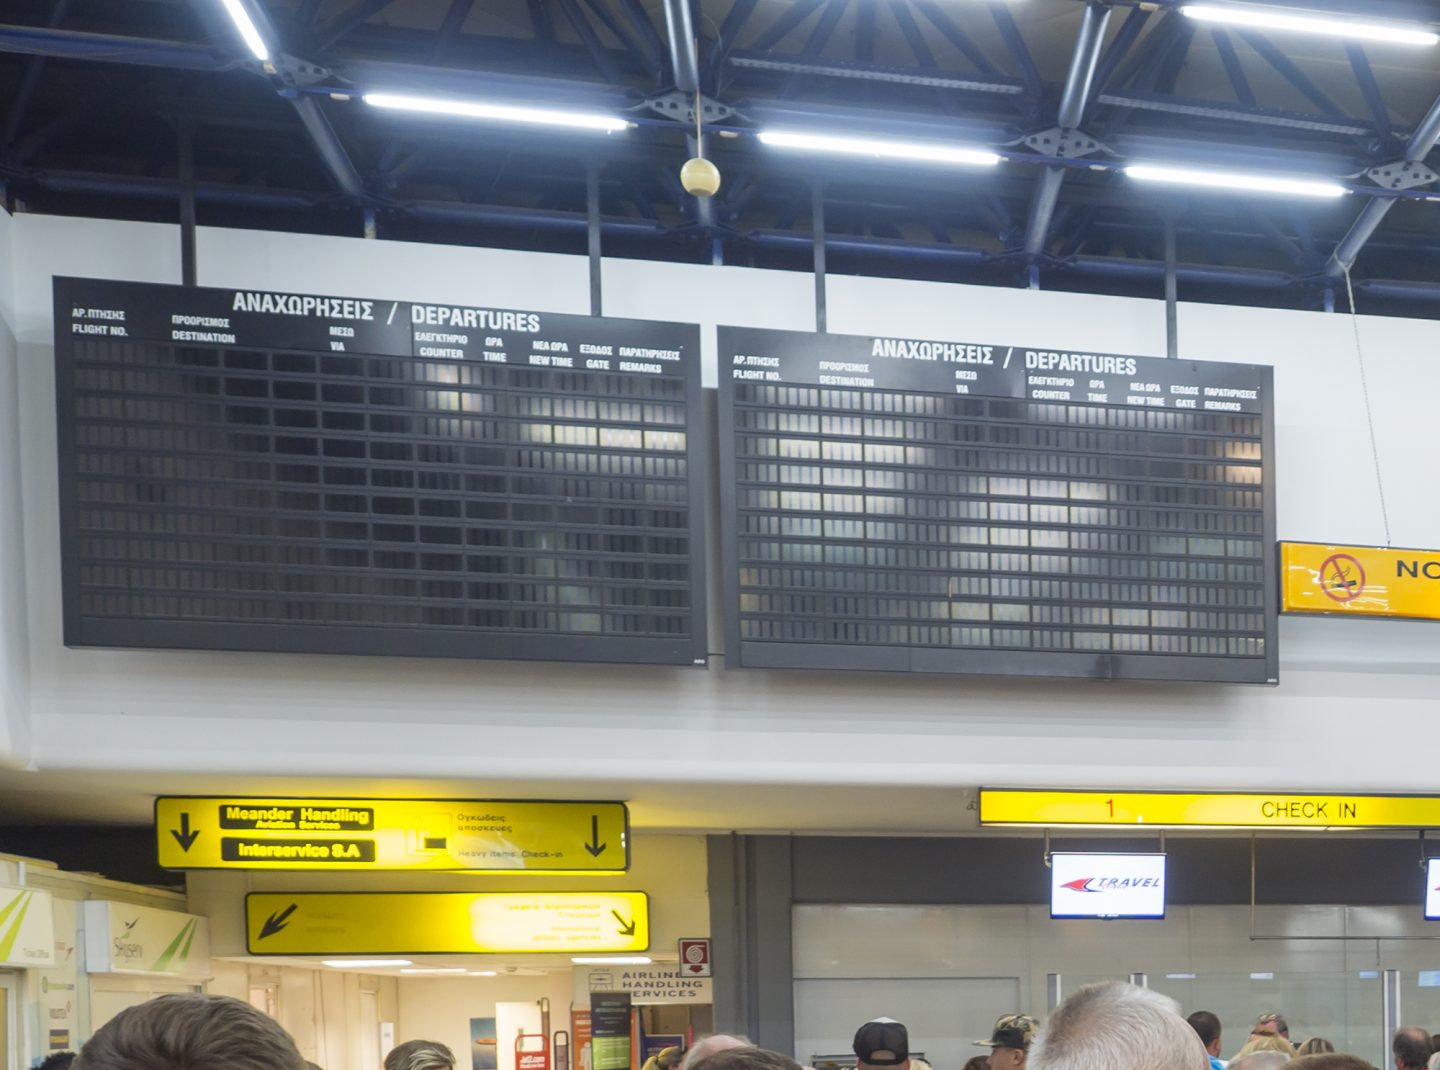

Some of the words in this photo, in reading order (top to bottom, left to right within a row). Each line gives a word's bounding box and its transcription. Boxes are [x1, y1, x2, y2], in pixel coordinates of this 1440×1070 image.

[232, 291, 374, 321] ΑΝΑΧΩΡΗΣΕΙΣ
[386, 302, 398, 325] /
[412, 305, 540, 332] DEPARTURES
[172, 315, 230, 328] ΠΡΟΟΡΙΣΜΟΣ
[72, 324, 108, 335] FLIGHT
[110, 326, 128, 336] NO.
[329, 326, 354, 337] ΜΕΣΩ
[172, 330, 236, 344] DESTINATION
[414, 332, 468, 344] ΕΛΕΓΚΤΗΡΙΟ
[485, 337, 503, 348] ΩΡΑ
[330, 341, 345, 351] VIA
[532, 340, 550, 350] ΝΕΑ
[550, 342, 568, 352] ΩΡΑ
[580, 344, 613, 356] ΕΞΟΔΟΣ
[420, 347, 464, 360] COUNTER
[483, 351, 507, 363] TIME
[620, 347, 680, 361] ΠΑΡΑΤΗΡΗΣΕΙΣ
[872, 338, 994, 365] ΑΝΑΧΩΡΗΣΕΙΣ
[1003, 347, 1014, 368] /
[1026, 351, 1137, 376] DEPARTURES
[529, 355, 550, 366] NEW
[550, 356, 573, 368] TIME
[586, 359, 610, 370] GATE
[620, 362, 662, 374] REMARKS
[733, 370, 764, 380] FLIGHT
[766, 371, 782, 381] NO.
[819, 374, 874, 388] DESTINATION
[956, 384, 969, 394] VIA
[1089, 380, 1104, 389] ΩΡΑ
[1130, 382, 1145, 392] ΝΕΑ
[1145, 384, 1161, 393] ΩΡΑ
[1032, 390, 1070, 400] COUNTER
[1088, 392, 1108, 403] TIME
[1127, 395, 1146, 405] NEW
[1146, 396, 1164, 406] TIME
[1176, 398, 1196, 409] GATE
[1204, 401, 1242, 412] REMARKS
[1105, 798, 1114, 818] 1
[1261, 801, 1328, 819] CHECK
[1338, 802, 1357, 819] IN
[226, 806, 293, 820] Meander
[300, 808, 369, 825] Handling
[255, 820, 296, 830] Aviation
[299, 821, 341, 830] Services
[238, 842, 330, 858] Interservice
[332, 844, 361, 859] S.A
[458, 850, 487, 859] Heavy
[521, 850, 564, 858] Check-in
[1098, 878, 1160, 888] TRAVEL
[622, 980, 703, 988] HANDLING
[632, 990, 697, 998] ERVICES
